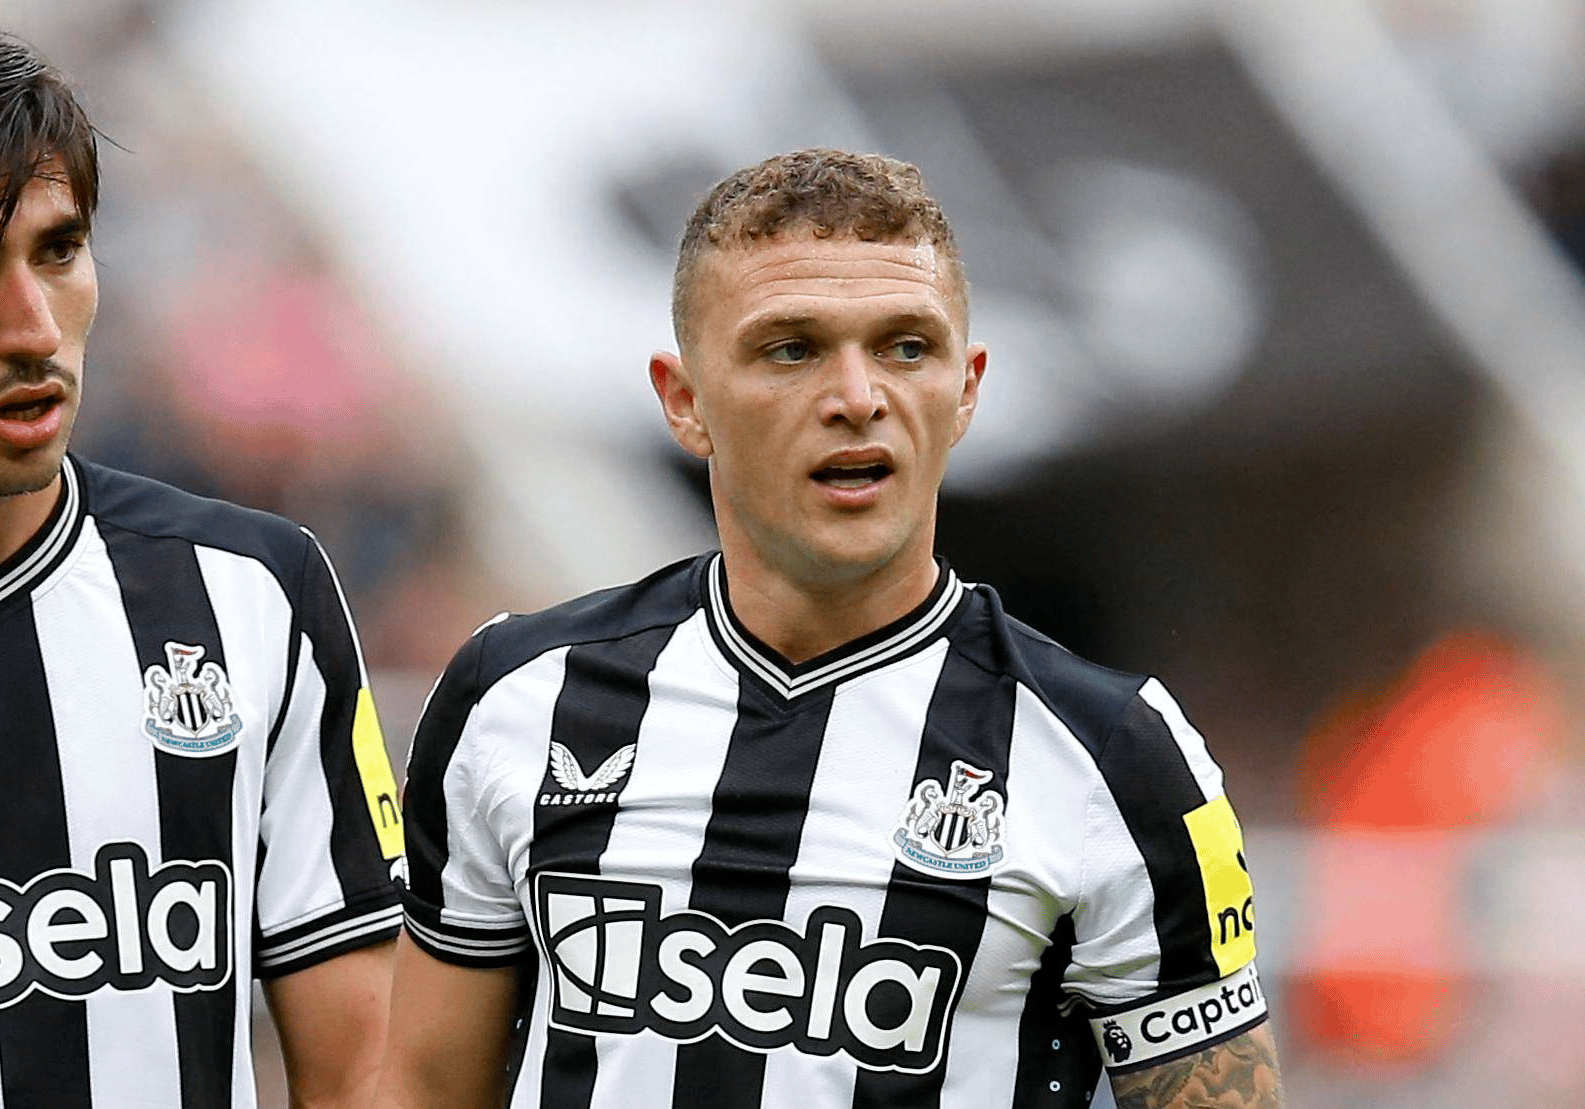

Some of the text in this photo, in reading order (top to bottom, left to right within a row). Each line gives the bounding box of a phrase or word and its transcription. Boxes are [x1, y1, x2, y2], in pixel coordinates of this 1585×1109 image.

[539, 792, 618, 806] CASTORE
[906, 847, 987, 870] NEWCASTLE UNITED
[648, 923, 943, 1052] sela
